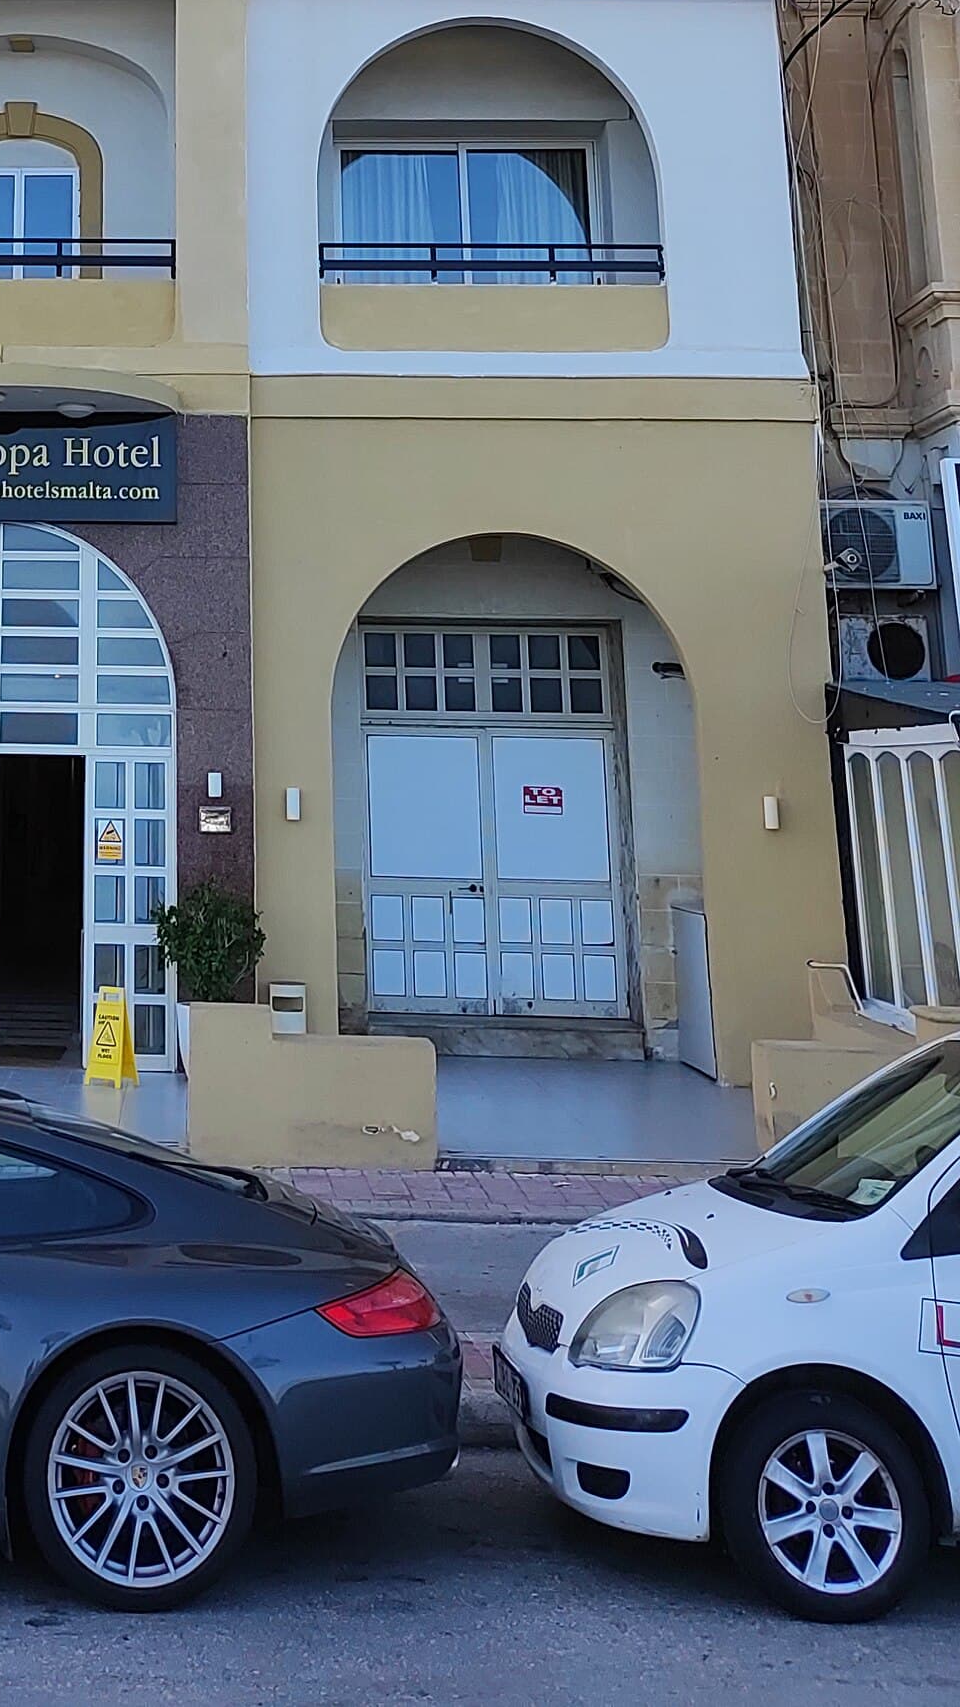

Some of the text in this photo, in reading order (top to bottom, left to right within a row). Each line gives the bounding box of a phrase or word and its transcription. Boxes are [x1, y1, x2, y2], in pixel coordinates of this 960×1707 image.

[62, 435, 162, 468] Hotel
[903, 511, 926, 521] BAXI
[529, 787, 556, 795] TO
[525, 795, 561, 804] LET
